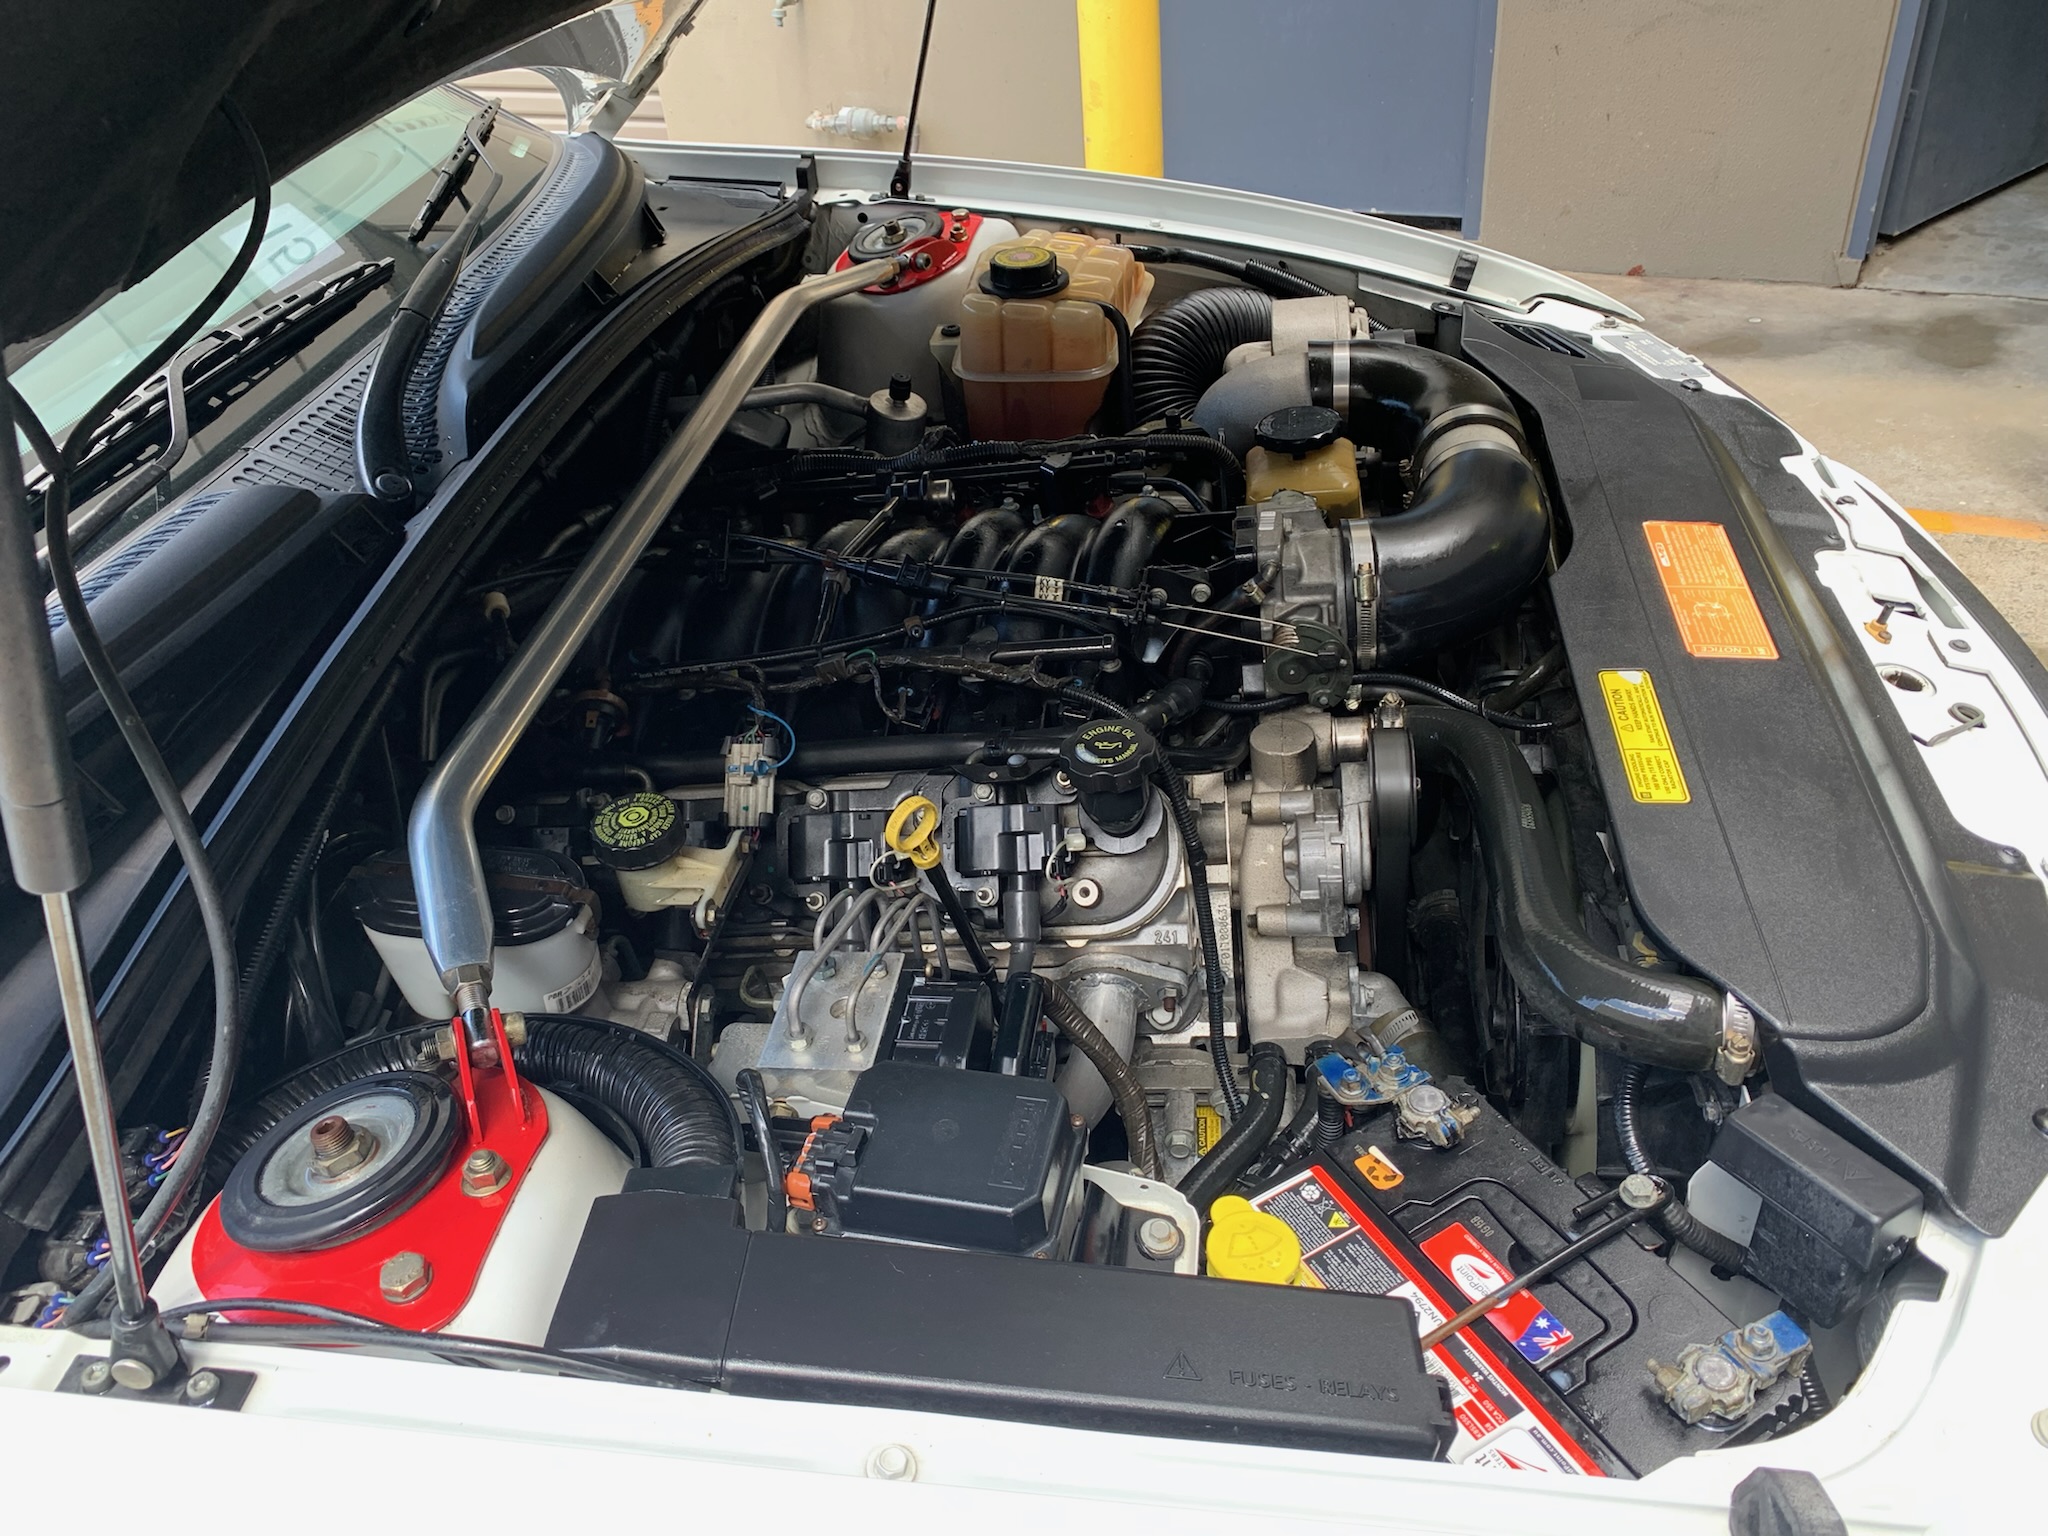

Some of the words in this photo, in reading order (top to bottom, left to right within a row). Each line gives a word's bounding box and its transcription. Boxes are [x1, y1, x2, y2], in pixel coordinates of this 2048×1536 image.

[1609, 688, 1629, 721] CAUTION
[1628, 702, 1639, 718] HANDS
[1633, 718, 1643, 730] KEEP
[1082, 725, 1122, 740] ENGINE
[1122, 729, 1136, 740] OIL
[1635, 751, 1646, 773] PRESSURE
[1641, 773, 1651, 790] SYSTEM
[618, 837, 646, 847] BEFORE
[649, 830, 662, 840] CAP
[1154, 930, 1178, 944] 241
[1463, 1233, 1480, 1250] OWNED
[1477, 1247, 1497, 1266] FAMILY
[1456, 1265, 1490, 1297] edPoint
[1411, 1292, 1444, 1327] UN2794
[1463, 1349, 1488, 1375] WARRANTY
[1472, 1371, 1484, 1383] 24
[1229, 1369, 1297, 1392] FUSES
[1319, 1378, 1400, 1403] RELAYS
[1468, 1384, 1478, 1393] RC
[1487, 1374, 1509, 1397] MONTHS
[1482, 1400, 1494, 1412] 550
[1495, 1412, 1506, 1424] CCA
